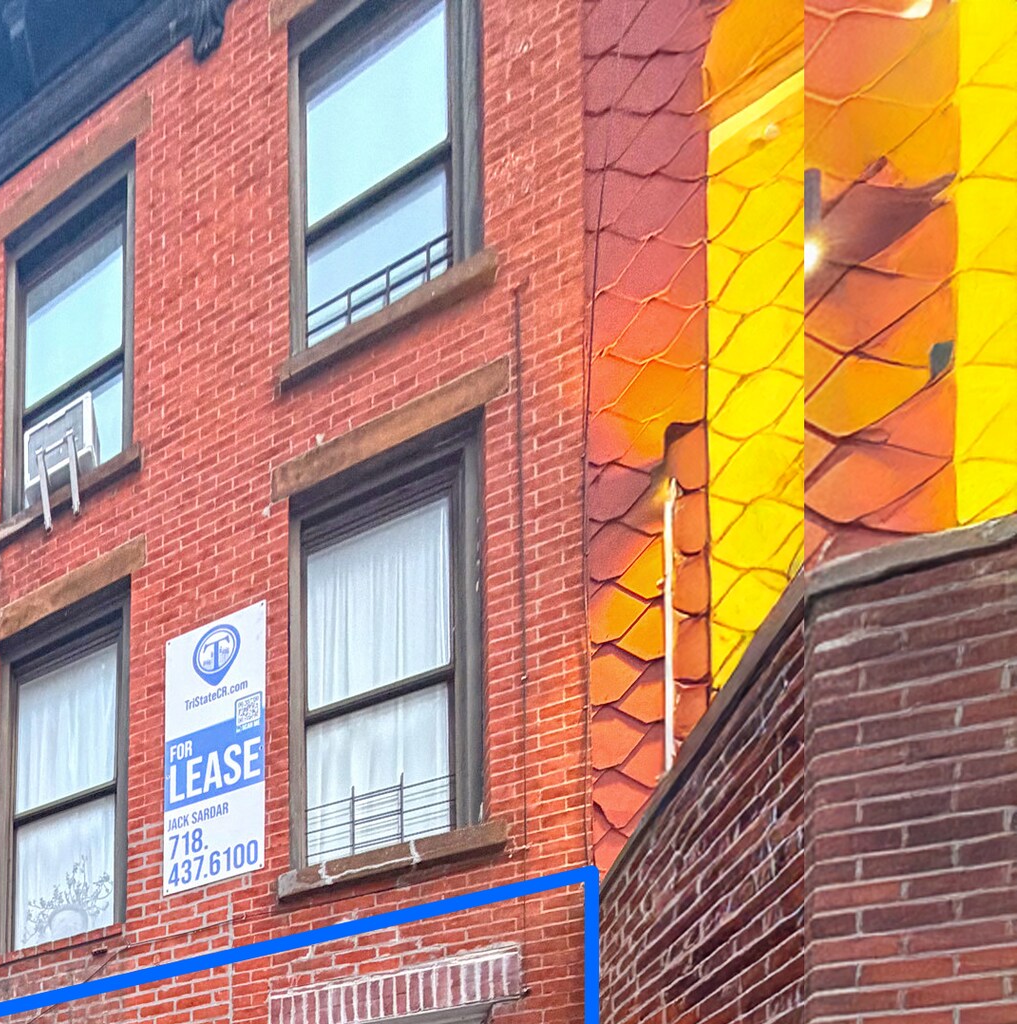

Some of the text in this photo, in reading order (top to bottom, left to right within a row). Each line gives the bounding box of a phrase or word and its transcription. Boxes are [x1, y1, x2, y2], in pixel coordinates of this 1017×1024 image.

[184, 680, 249, 712] TriStateCR.com
[169, 740, 193, 764] FOR
[169, 736, 262, 805] LEASE
[168, 802, 230, 833] JACK SARDAR
[168, 828, 209, 860] 718.
[168, 838, 260, 888] 437.6100
